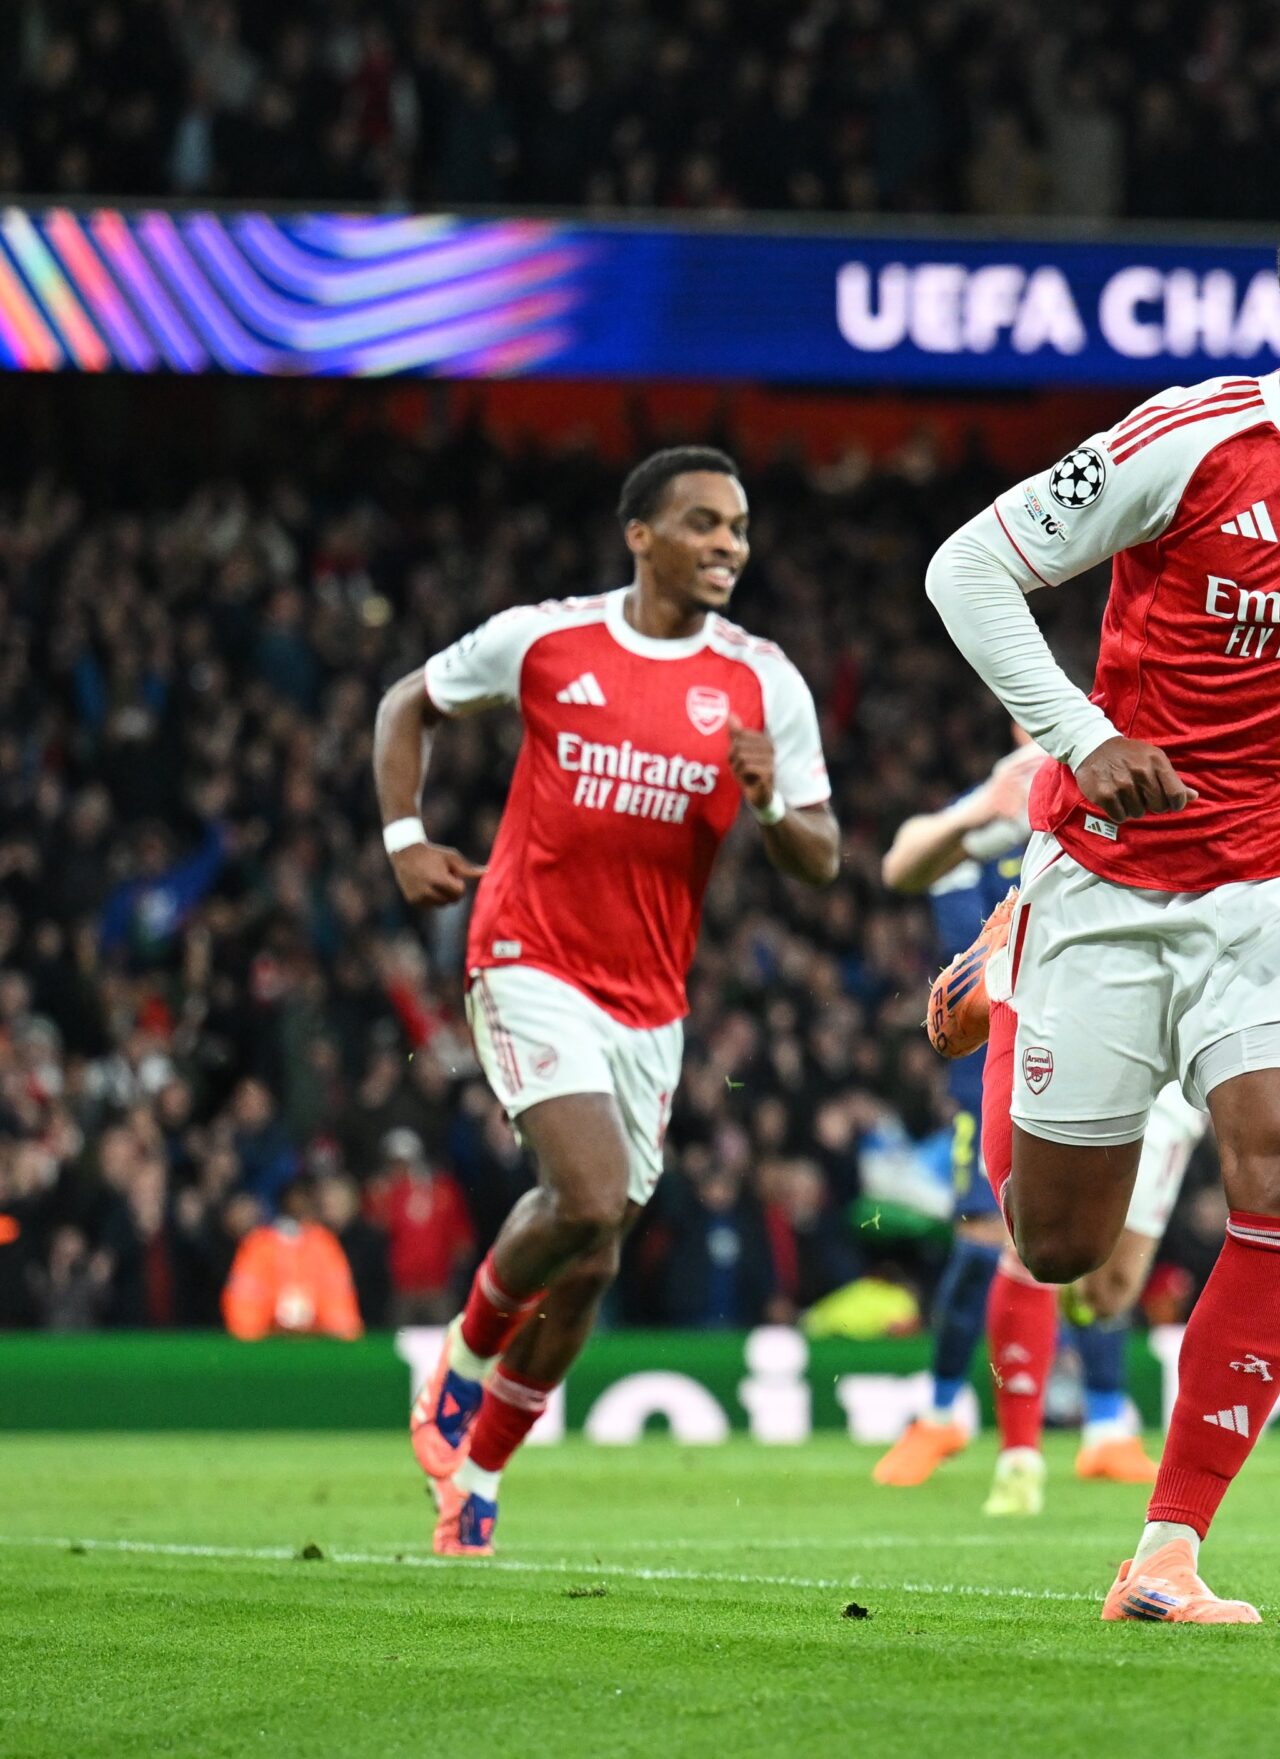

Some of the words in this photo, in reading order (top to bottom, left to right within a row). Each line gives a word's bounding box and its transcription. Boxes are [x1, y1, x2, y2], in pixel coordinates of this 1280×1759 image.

[836, 260, 1086, 355] UEFA
[1225, 624, 1277, 659] FLY
[557, 731, 720, 795] Emirates
[573, 774, 614, 810] FLY
[613, 781, 690, 826] BETTER
